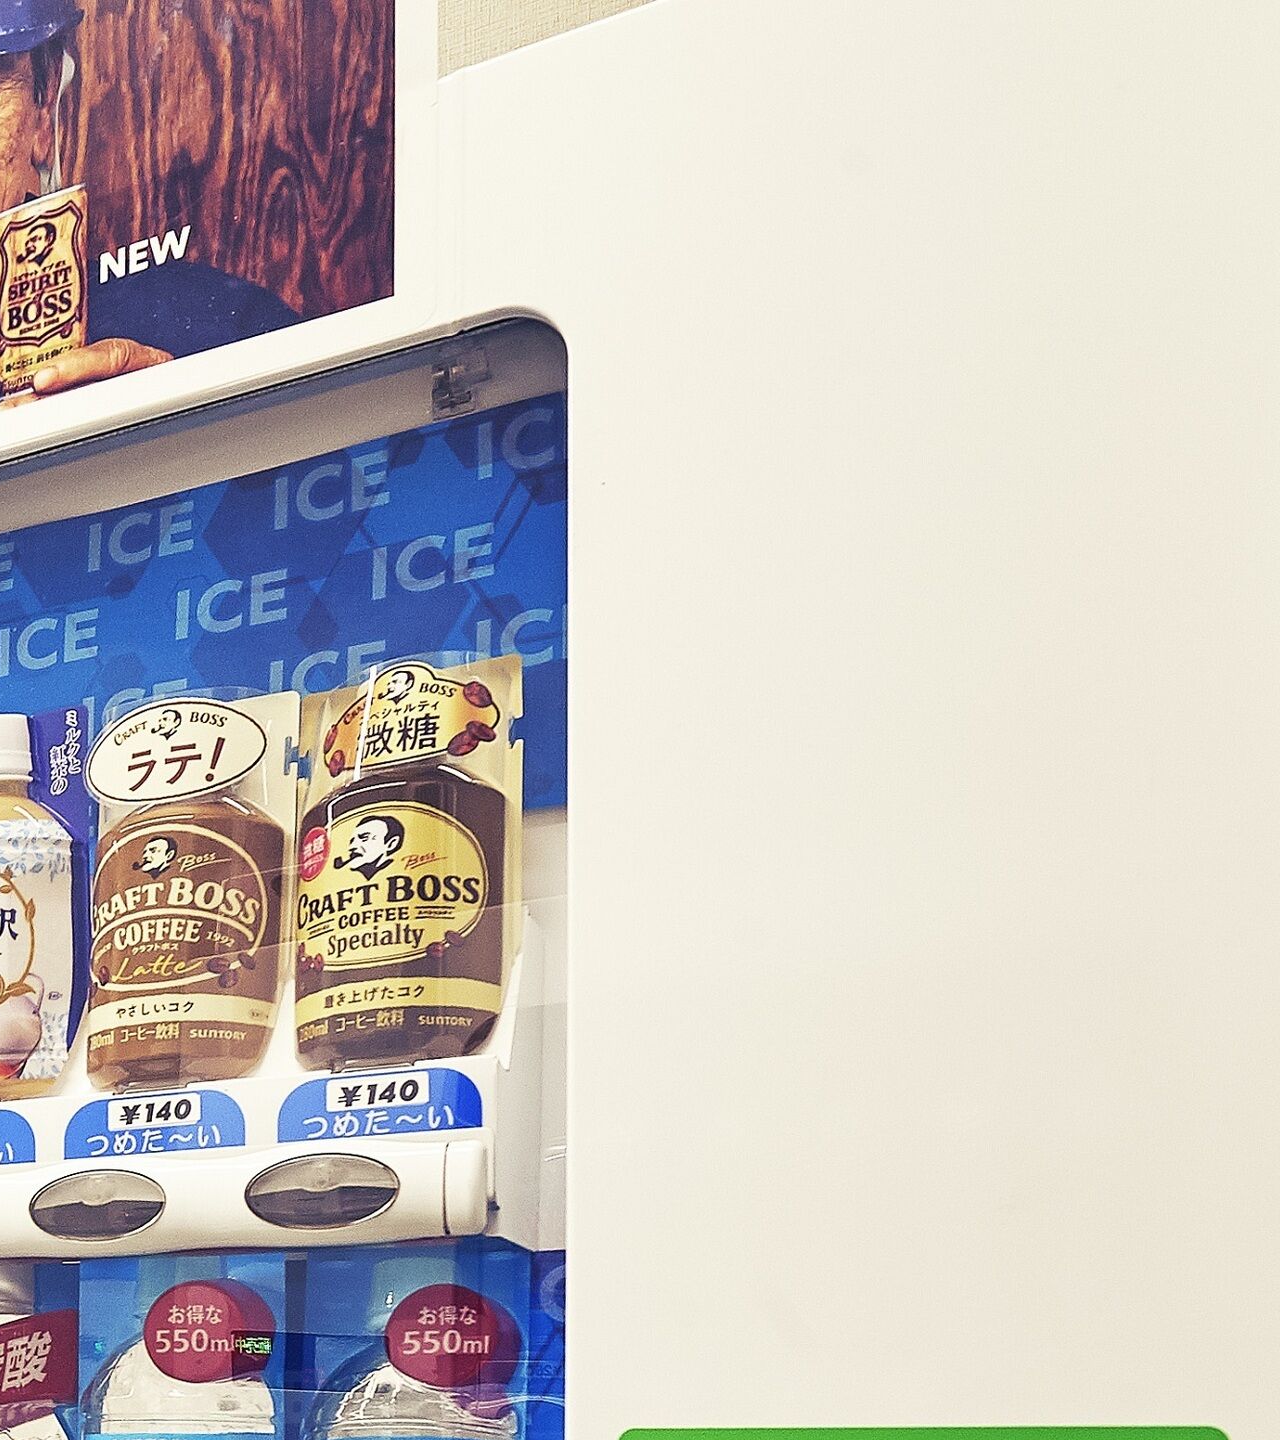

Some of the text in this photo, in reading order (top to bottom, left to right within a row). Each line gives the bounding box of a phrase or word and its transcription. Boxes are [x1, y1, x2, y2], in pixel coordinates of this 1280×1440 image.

[99, 225, 191, 284] NEW
[7, 290, 72, 331] BOSS
[87, 501, 194, 572] ICE
[175, 569, 288, 641] ICE
[419, 682, 457, 698] BOSS
[362, 716, 439, 757] 微糖
[298, 875, 479, 930] CRAFT BOSS
[338, 907, 410, 930] COFFEE
[114, 918, 204, 951] COFFEE
[327, 922, 424, 958] Specialty
[111, 954, 202, 982] Latte
[115, 1001, 195, 1018] やさしいコク
[337, 1080, 420, 1107] ¥140
[167, 1304, 223, 1324] お得な
[418, 1305, 477, 1326] お得な
[154, 1329, 237, 1354] 550ml
[403, 1330, 491, 1355] 550ml
